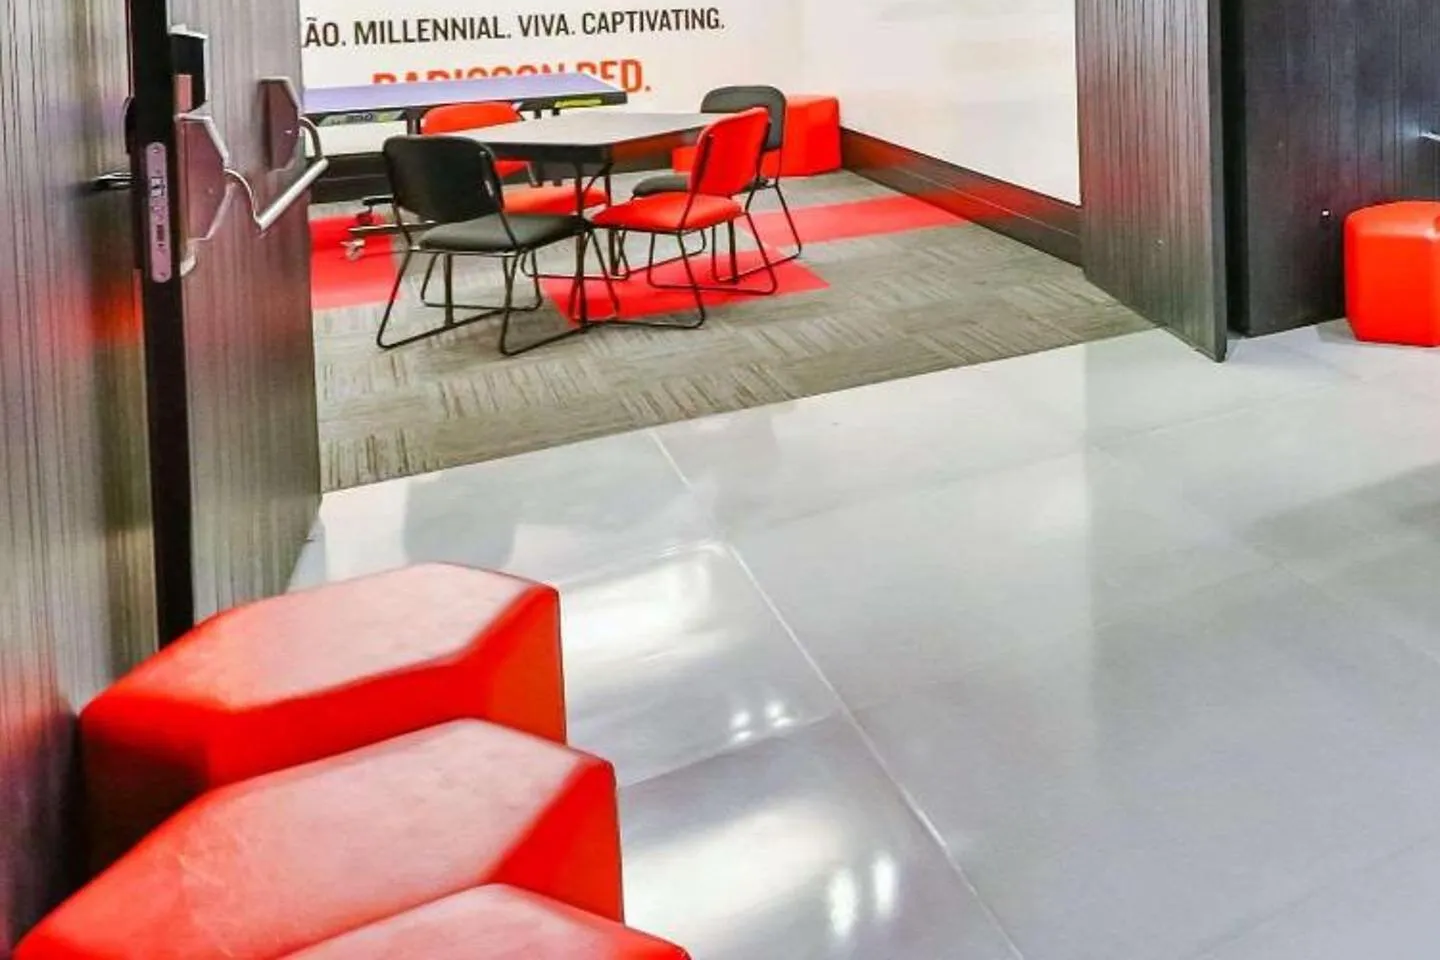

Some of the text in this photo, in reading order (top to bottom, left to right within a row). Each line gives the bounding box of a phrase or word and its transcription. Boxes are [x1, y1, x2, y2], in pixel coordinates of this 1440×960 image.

[355, 16, 511, 45] MILLENNIAL.
[518, 14, 575, 37] VIVA.
[582, 7, 725, 35] CAPTIVATING.
